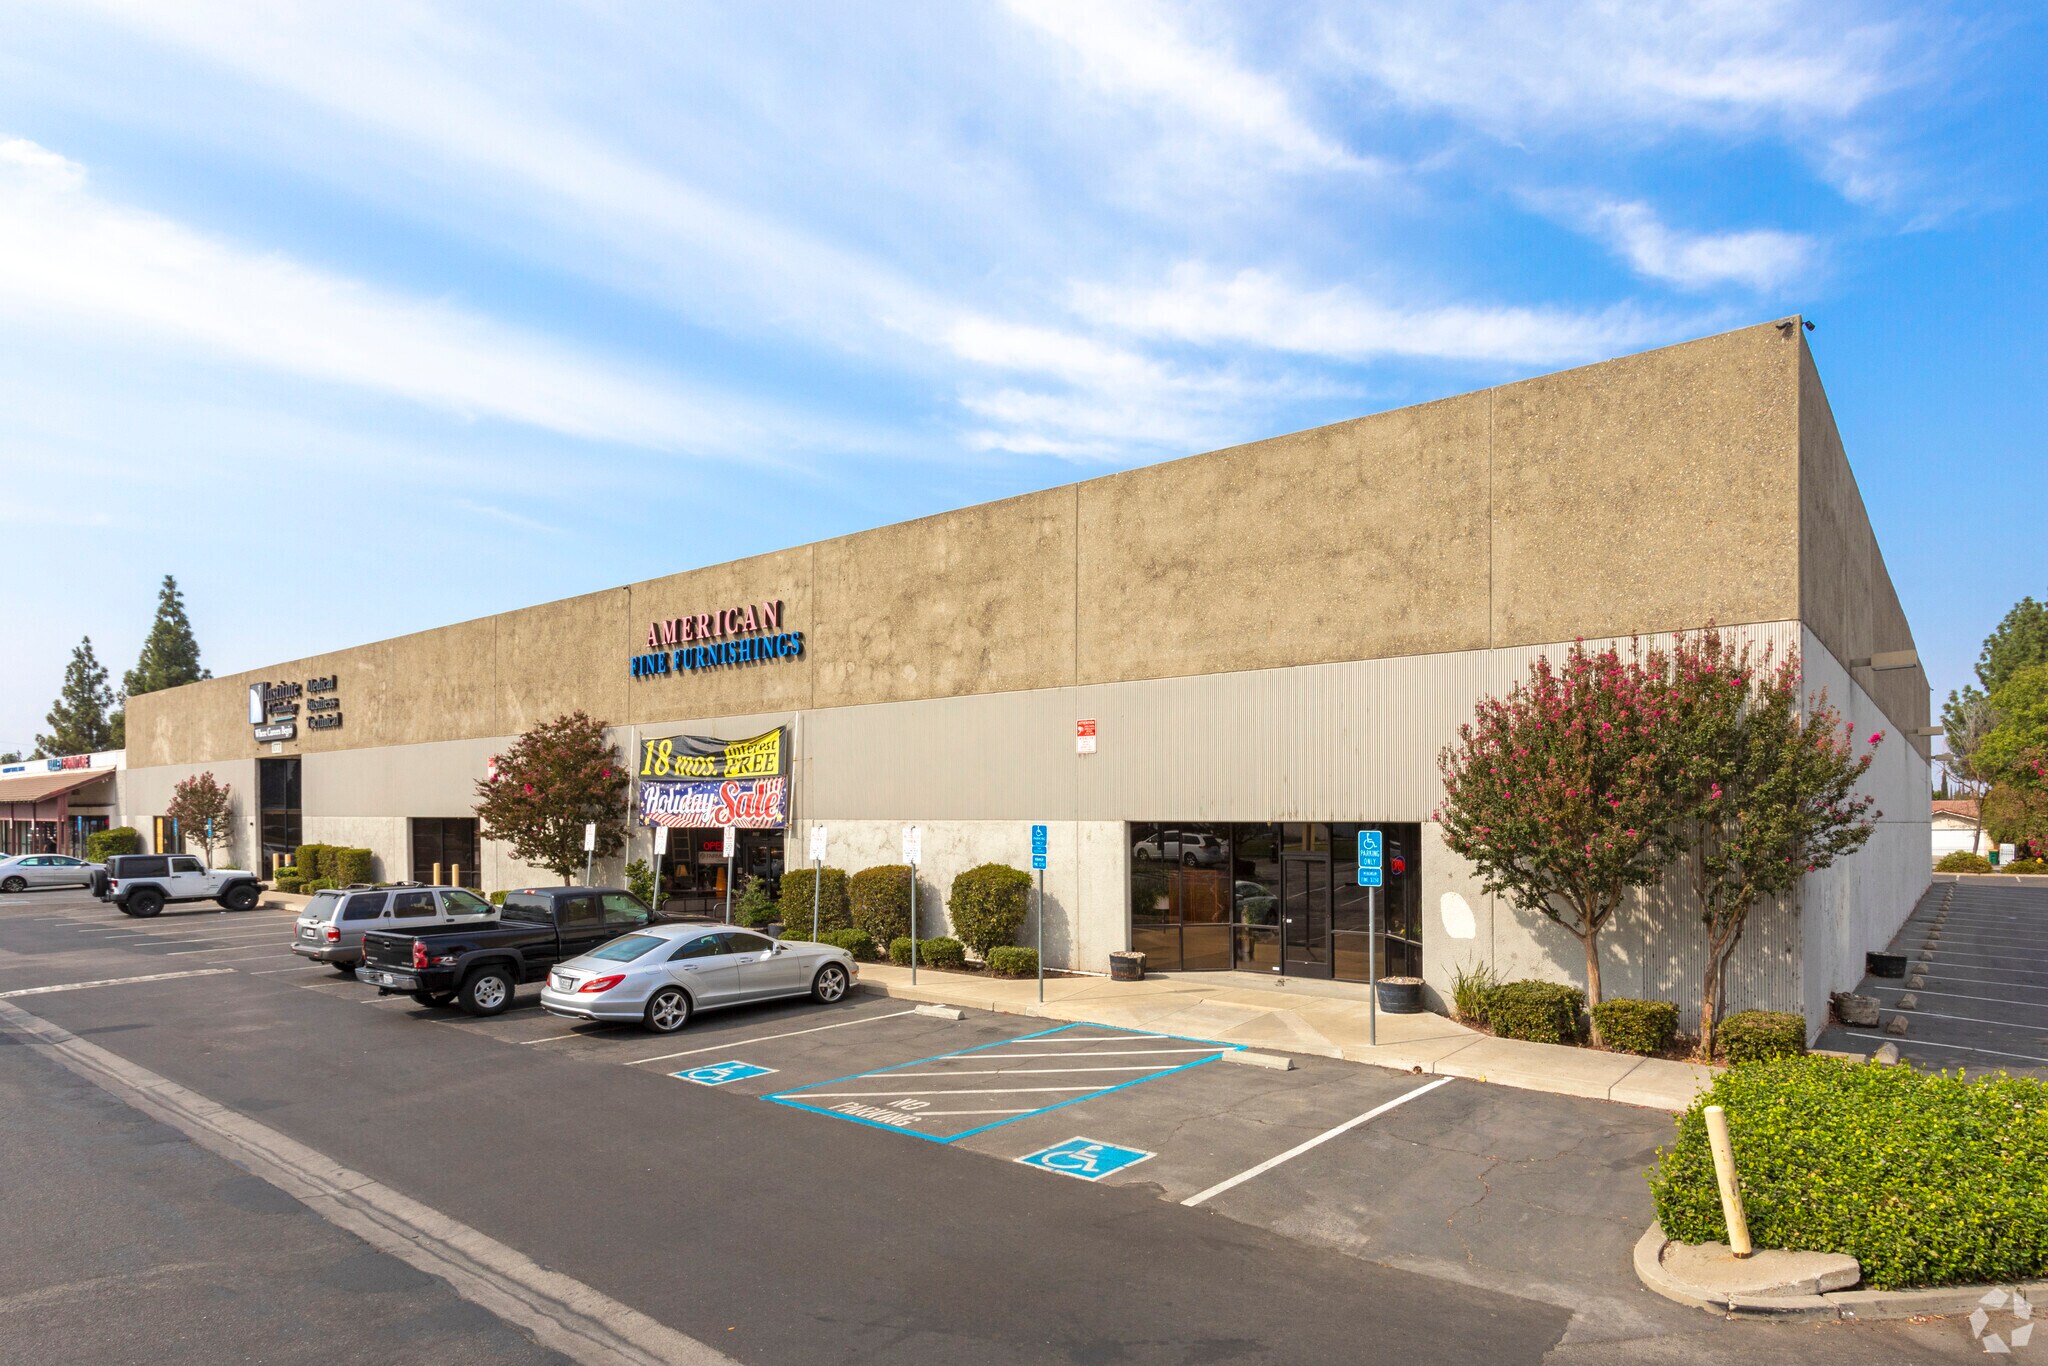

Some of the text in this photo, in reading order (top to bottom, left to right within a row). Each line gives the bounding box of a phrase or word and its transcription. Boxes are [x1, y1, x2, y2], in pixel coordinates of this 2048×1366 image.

[646, 600, 780, 647] AMERICAN
[630, 631, 800, 677] FINE FURNISHINGS
[264, 682, 301, 701] Institute
[307, 676, 336, 691] Medical
[307, 698, 338, 710] Business
[307, 713, 341, 729] Technical
[640, 738, 776, 776] 18 mos. FREE
[728, 740, 777, 758] interest
[644, 780, 780, 825] Holiday Sale
[703, 841, 724, 851] OPE
[1363, 857, 1377, 865] ONLY
[1391, 859, 1405, 871] OPEN
[886, 1098, 931, 1111] NO
[828, 1101, 922, 1126] PARKING
